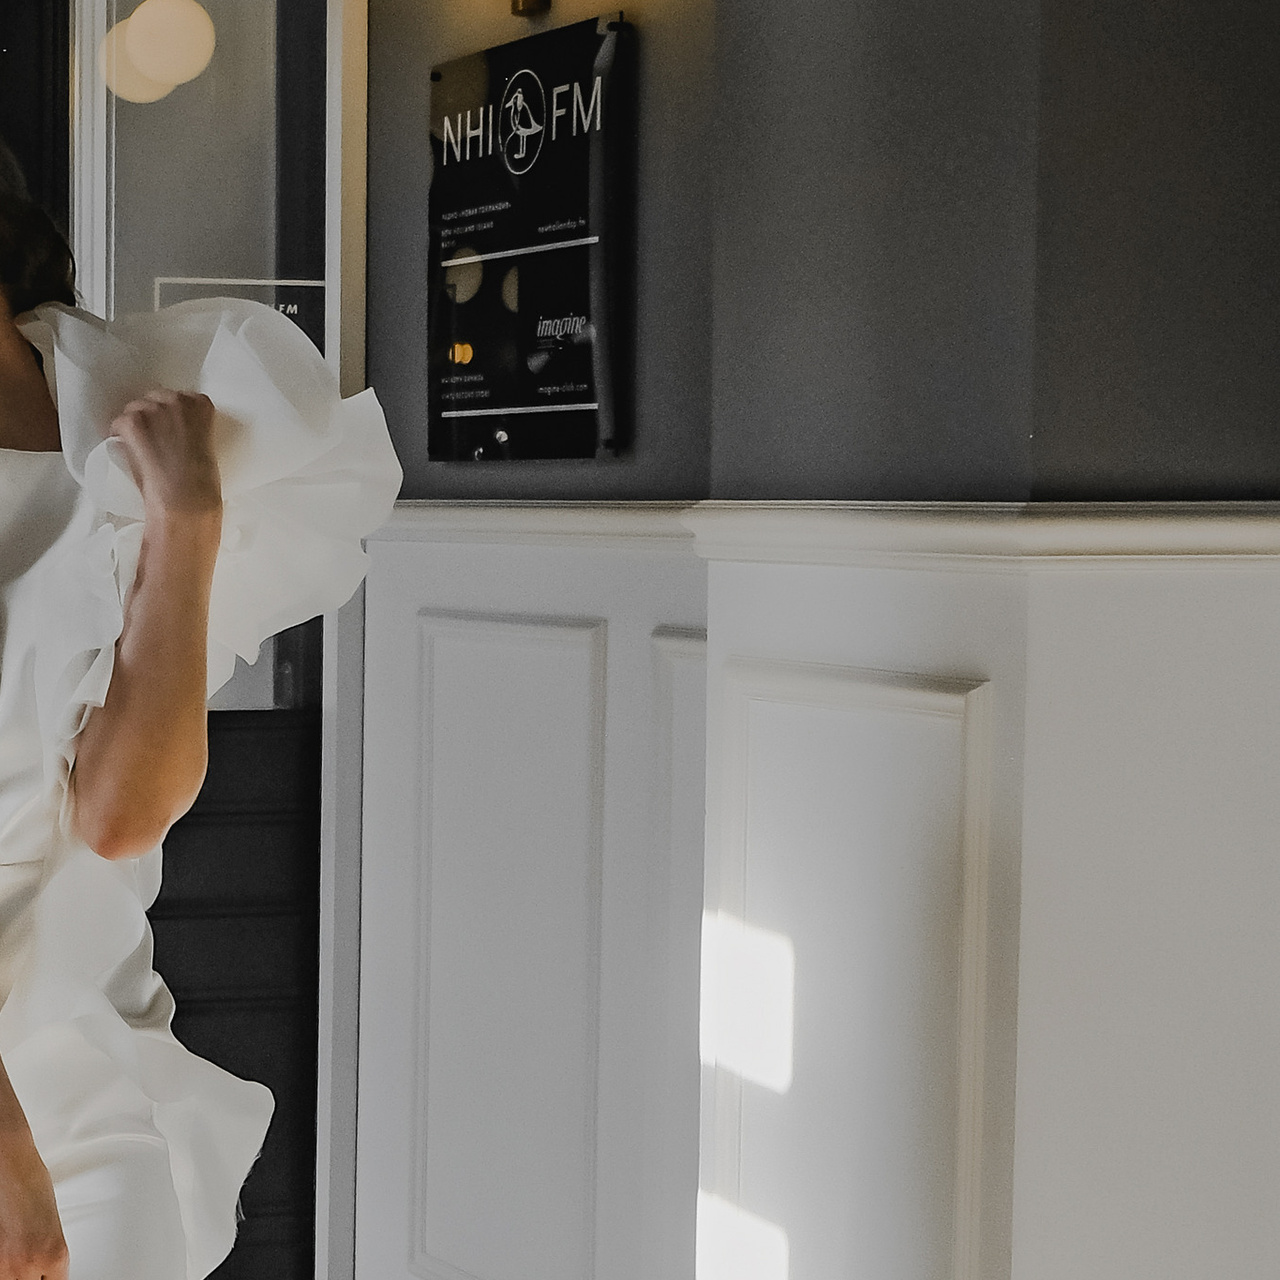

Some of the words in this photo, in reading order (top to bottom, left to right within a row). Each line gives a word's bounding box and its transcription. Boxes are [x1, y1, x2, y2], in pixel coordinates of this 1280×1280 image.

[443, 104, 494, 166] NHI
[552, 76, 602, 141] FM
[279, 304, 298, 315] FM
[536, 312, 587, 341] imagine
